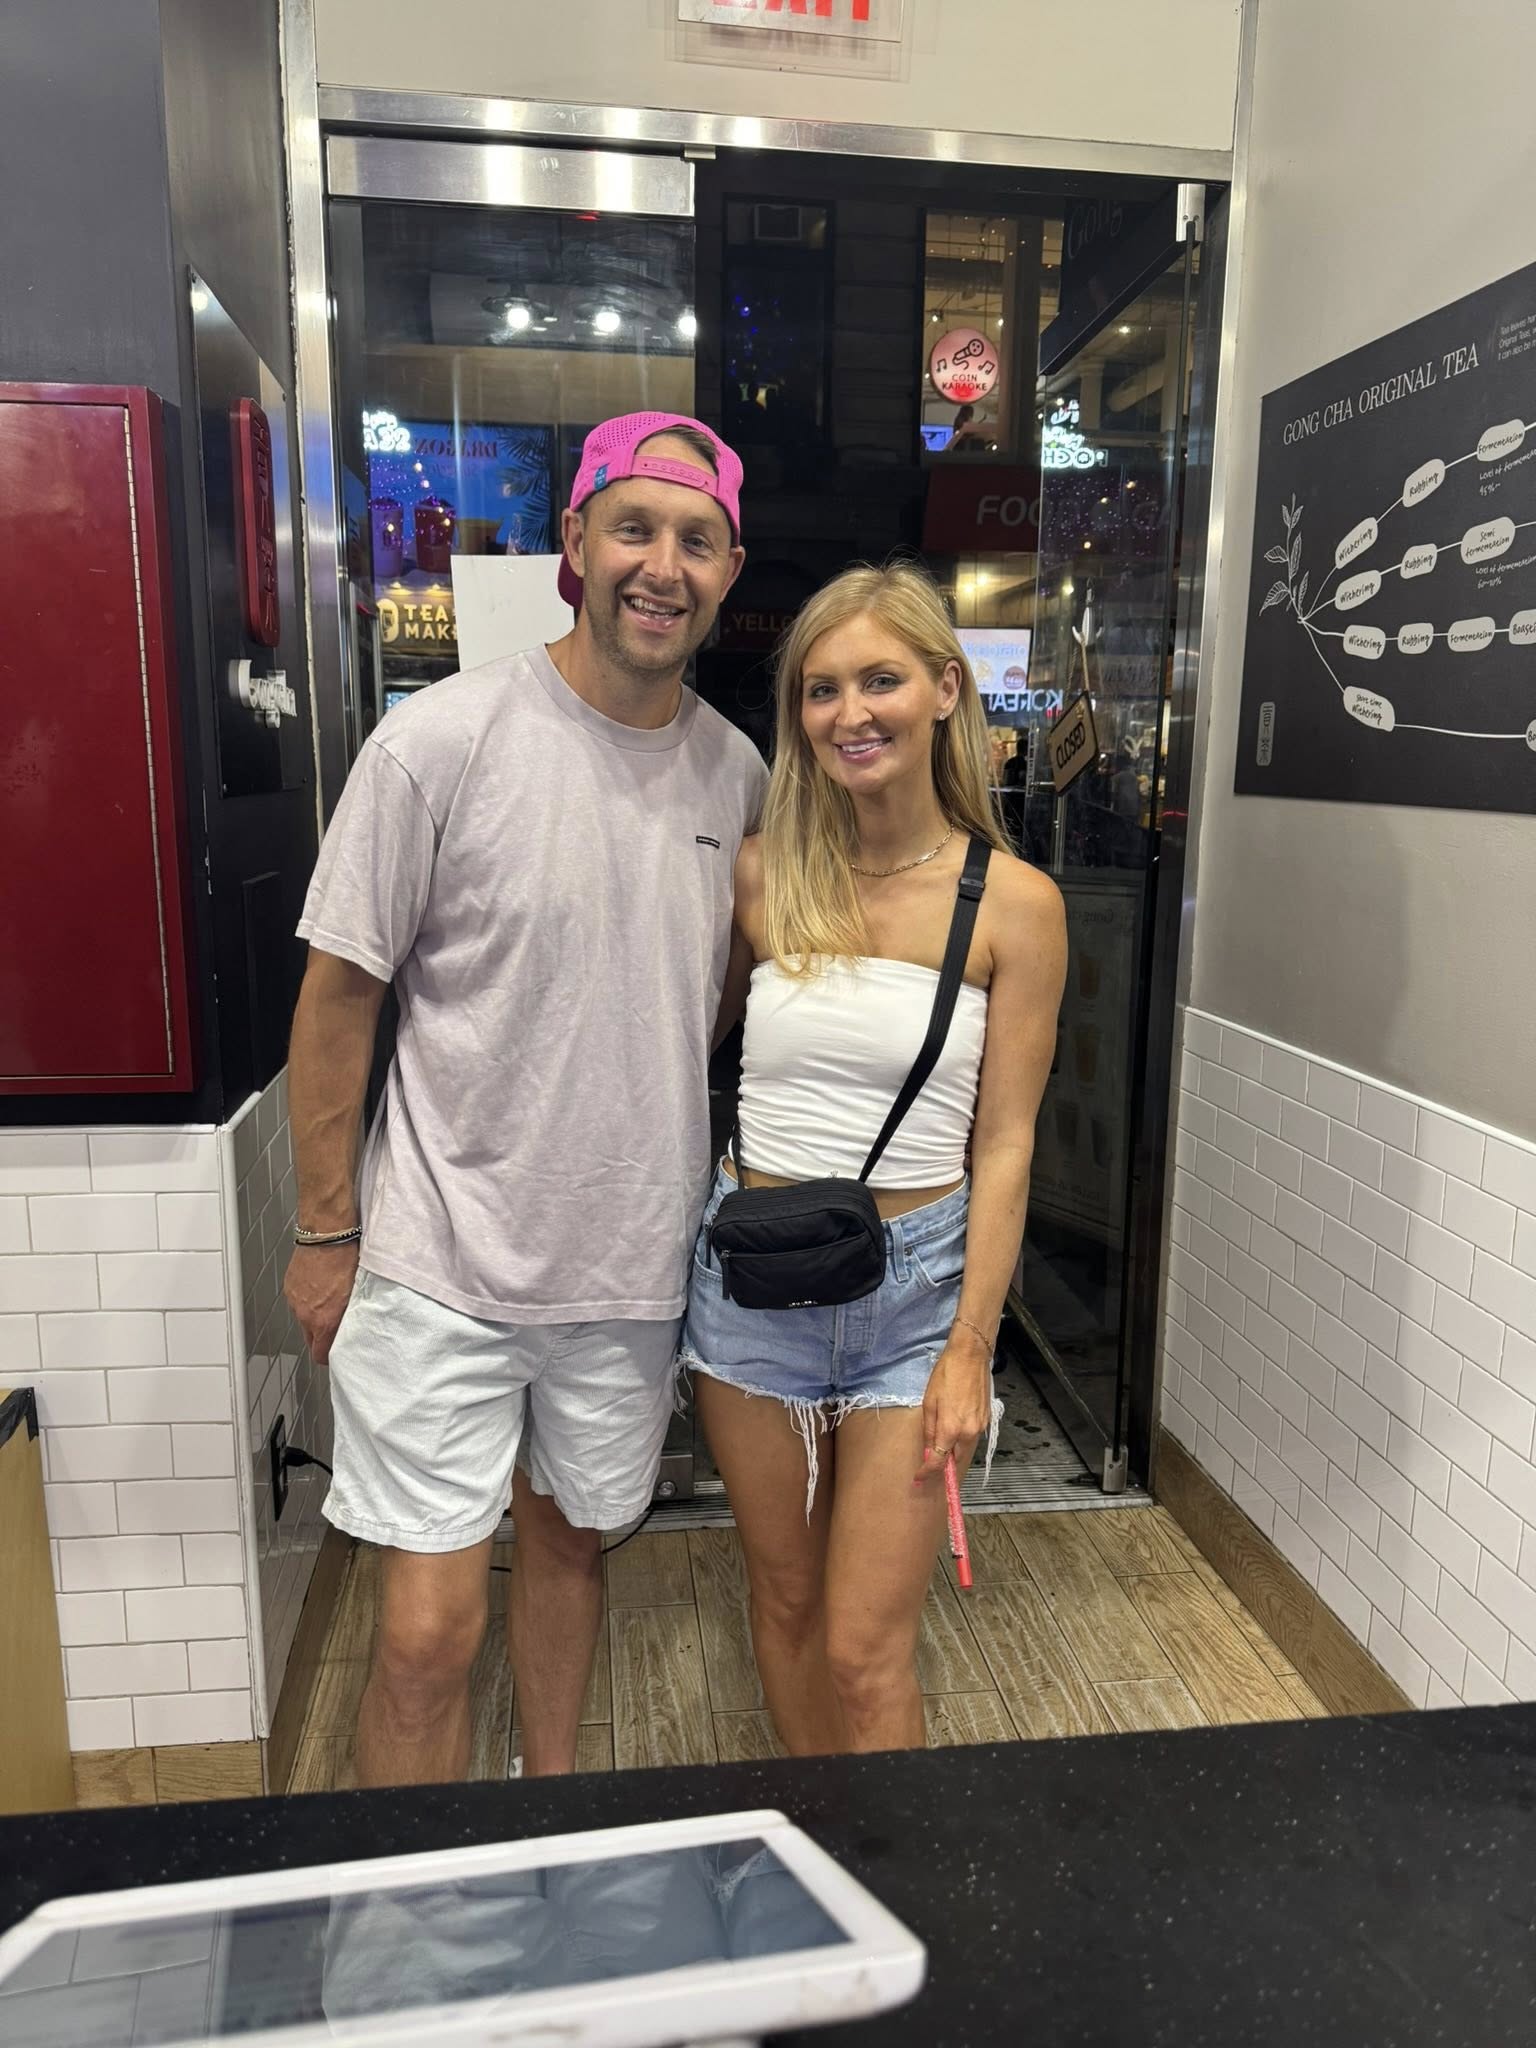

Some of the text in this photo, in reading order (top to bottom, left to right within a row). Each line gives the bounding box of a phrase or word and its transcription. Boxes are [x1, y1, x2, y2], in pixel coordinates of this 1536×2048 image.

[942, 381, 988, 391] KARAOKE
[951, 374, 978, 382] COIN
[1283, 343, 1479, 445] GONG CHA ORIGINAL TEA
[1409, 472, 1440, 497] Rubbing
[1338, 528, 1373, 561] Withering
[1479, 528, 1496, 542] Semi
[1404, 554, 1434, 571] Rubbing
[1340, 582, 1375, 603] Withering
[403, 604, 449, 622] TEA
[1348, 634, 1382, 654] Withering
[1401, 634, 1430, 647] Rubbing
[1352, 704, 1383, 726] Withering
[1056, 721, 1086, 769] CLOSED
